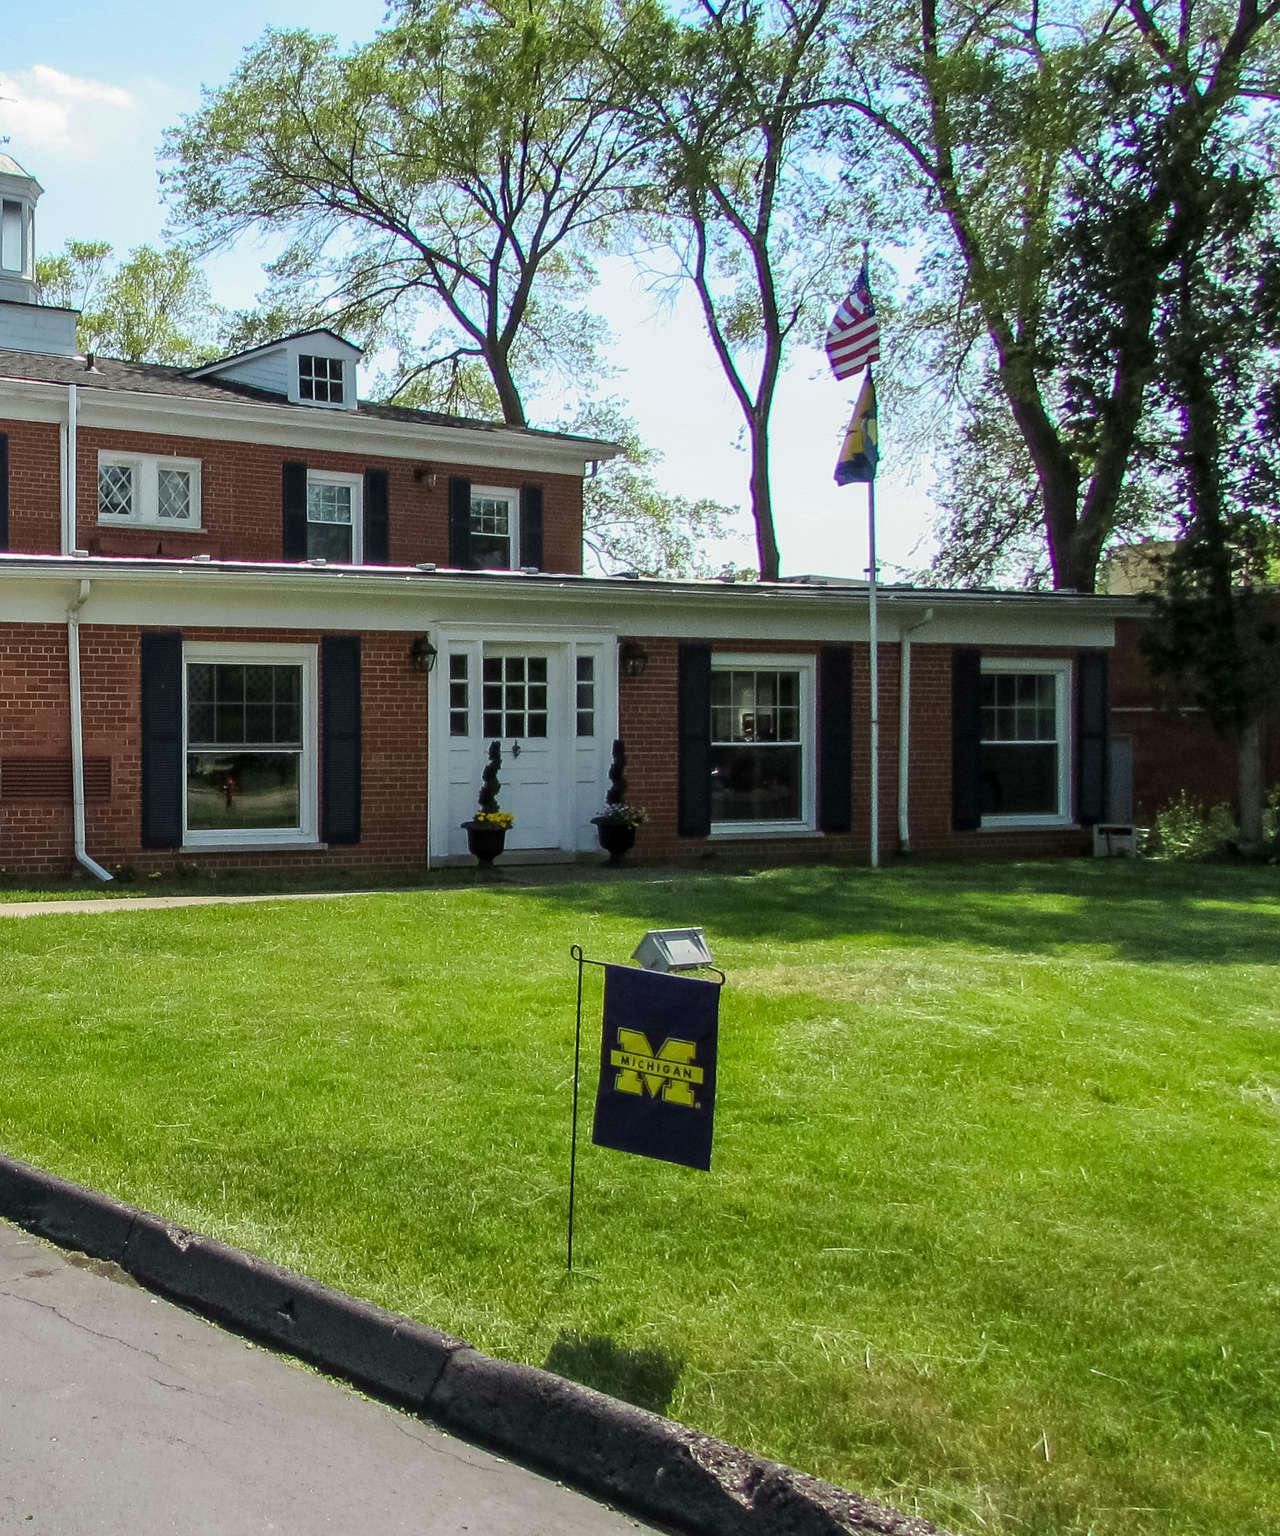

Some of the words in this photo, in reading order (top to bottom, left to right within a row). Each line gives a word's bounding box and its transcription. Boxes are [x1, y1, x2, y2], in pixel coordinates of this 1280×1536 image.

[3, 136, 11, 144] W
[614, 1027, 697, 1109] M
[621, 1055, 692, 1079] MICHIGAN
